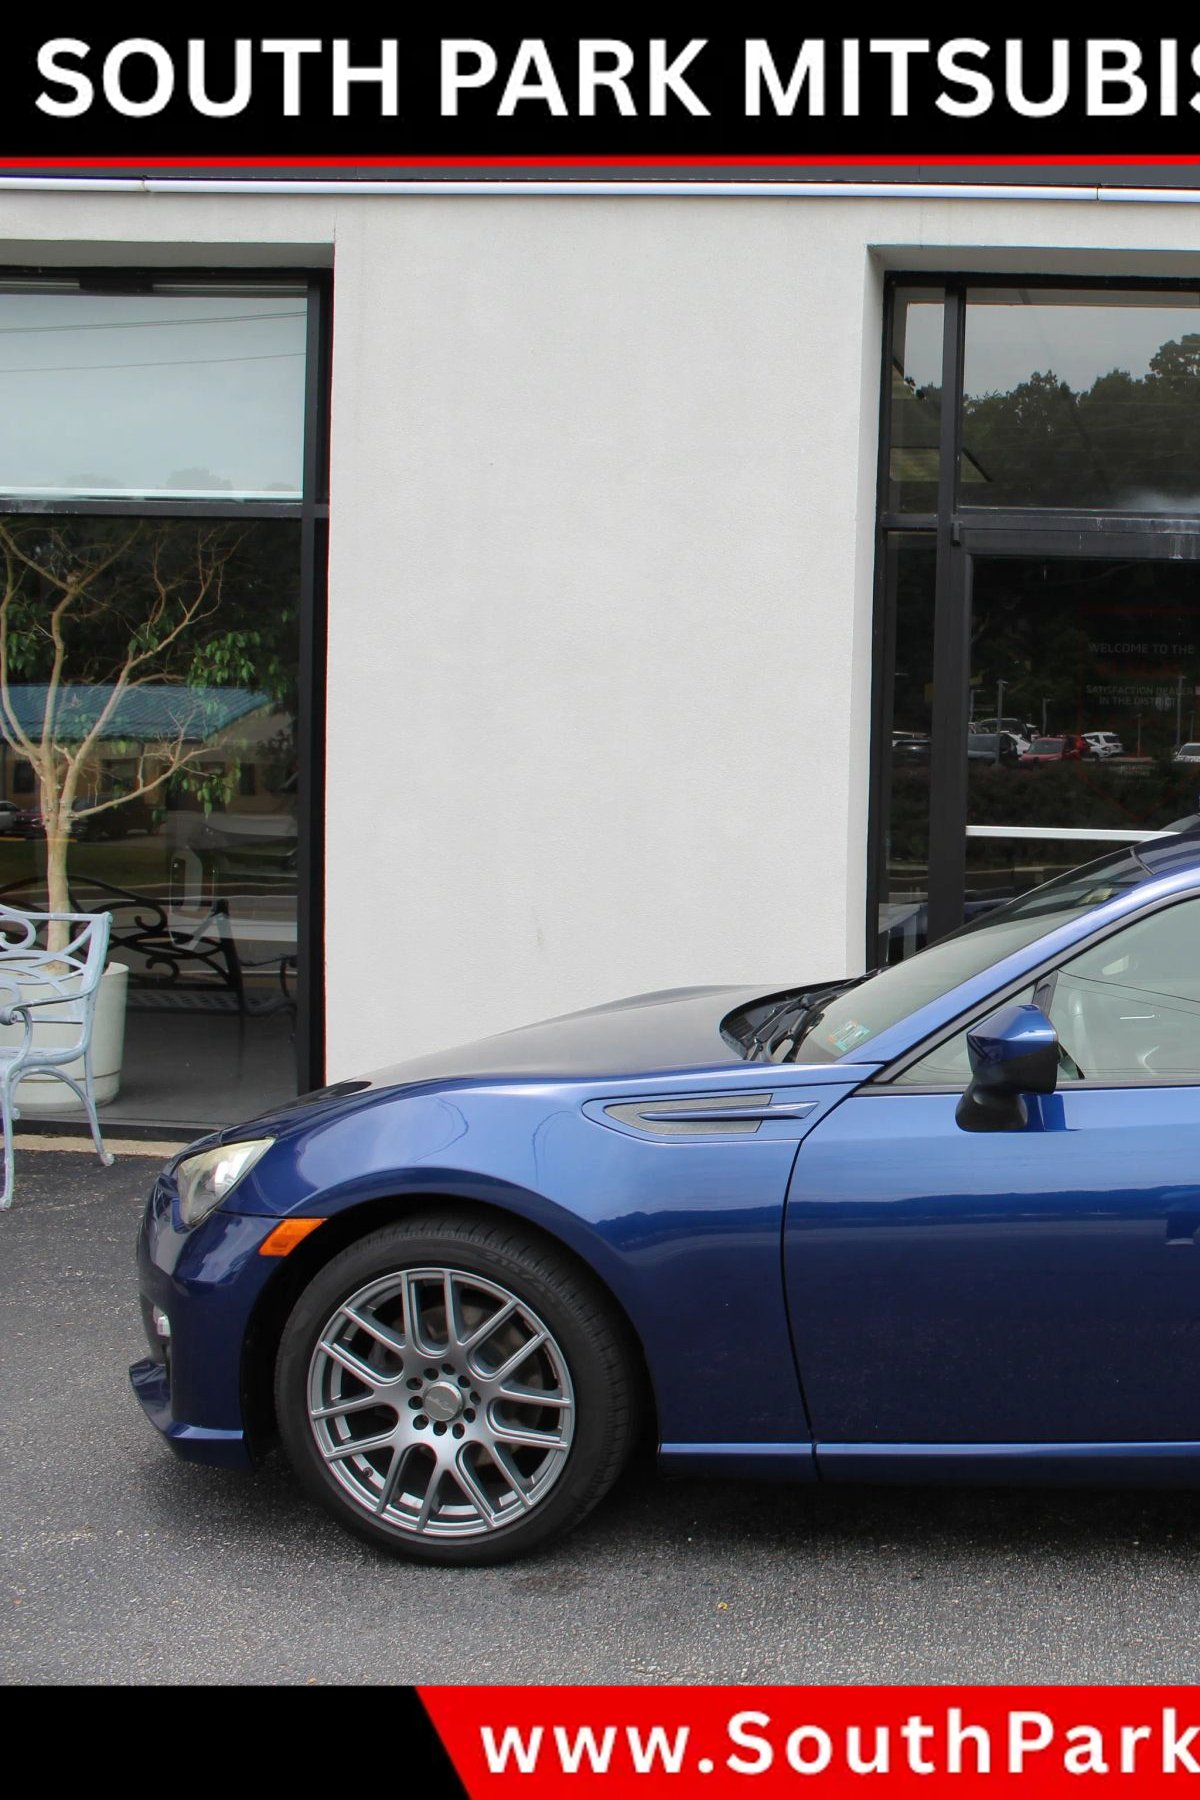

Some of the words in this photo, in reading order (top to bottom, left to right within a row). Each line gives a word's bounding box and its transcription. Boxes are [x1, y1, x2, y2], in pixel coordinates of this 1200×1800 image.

[1089, 642, 1149, 654] WELCOME
[1152, 643, 1168, 655] TO
[1170, 643, 1195, 655] THE
